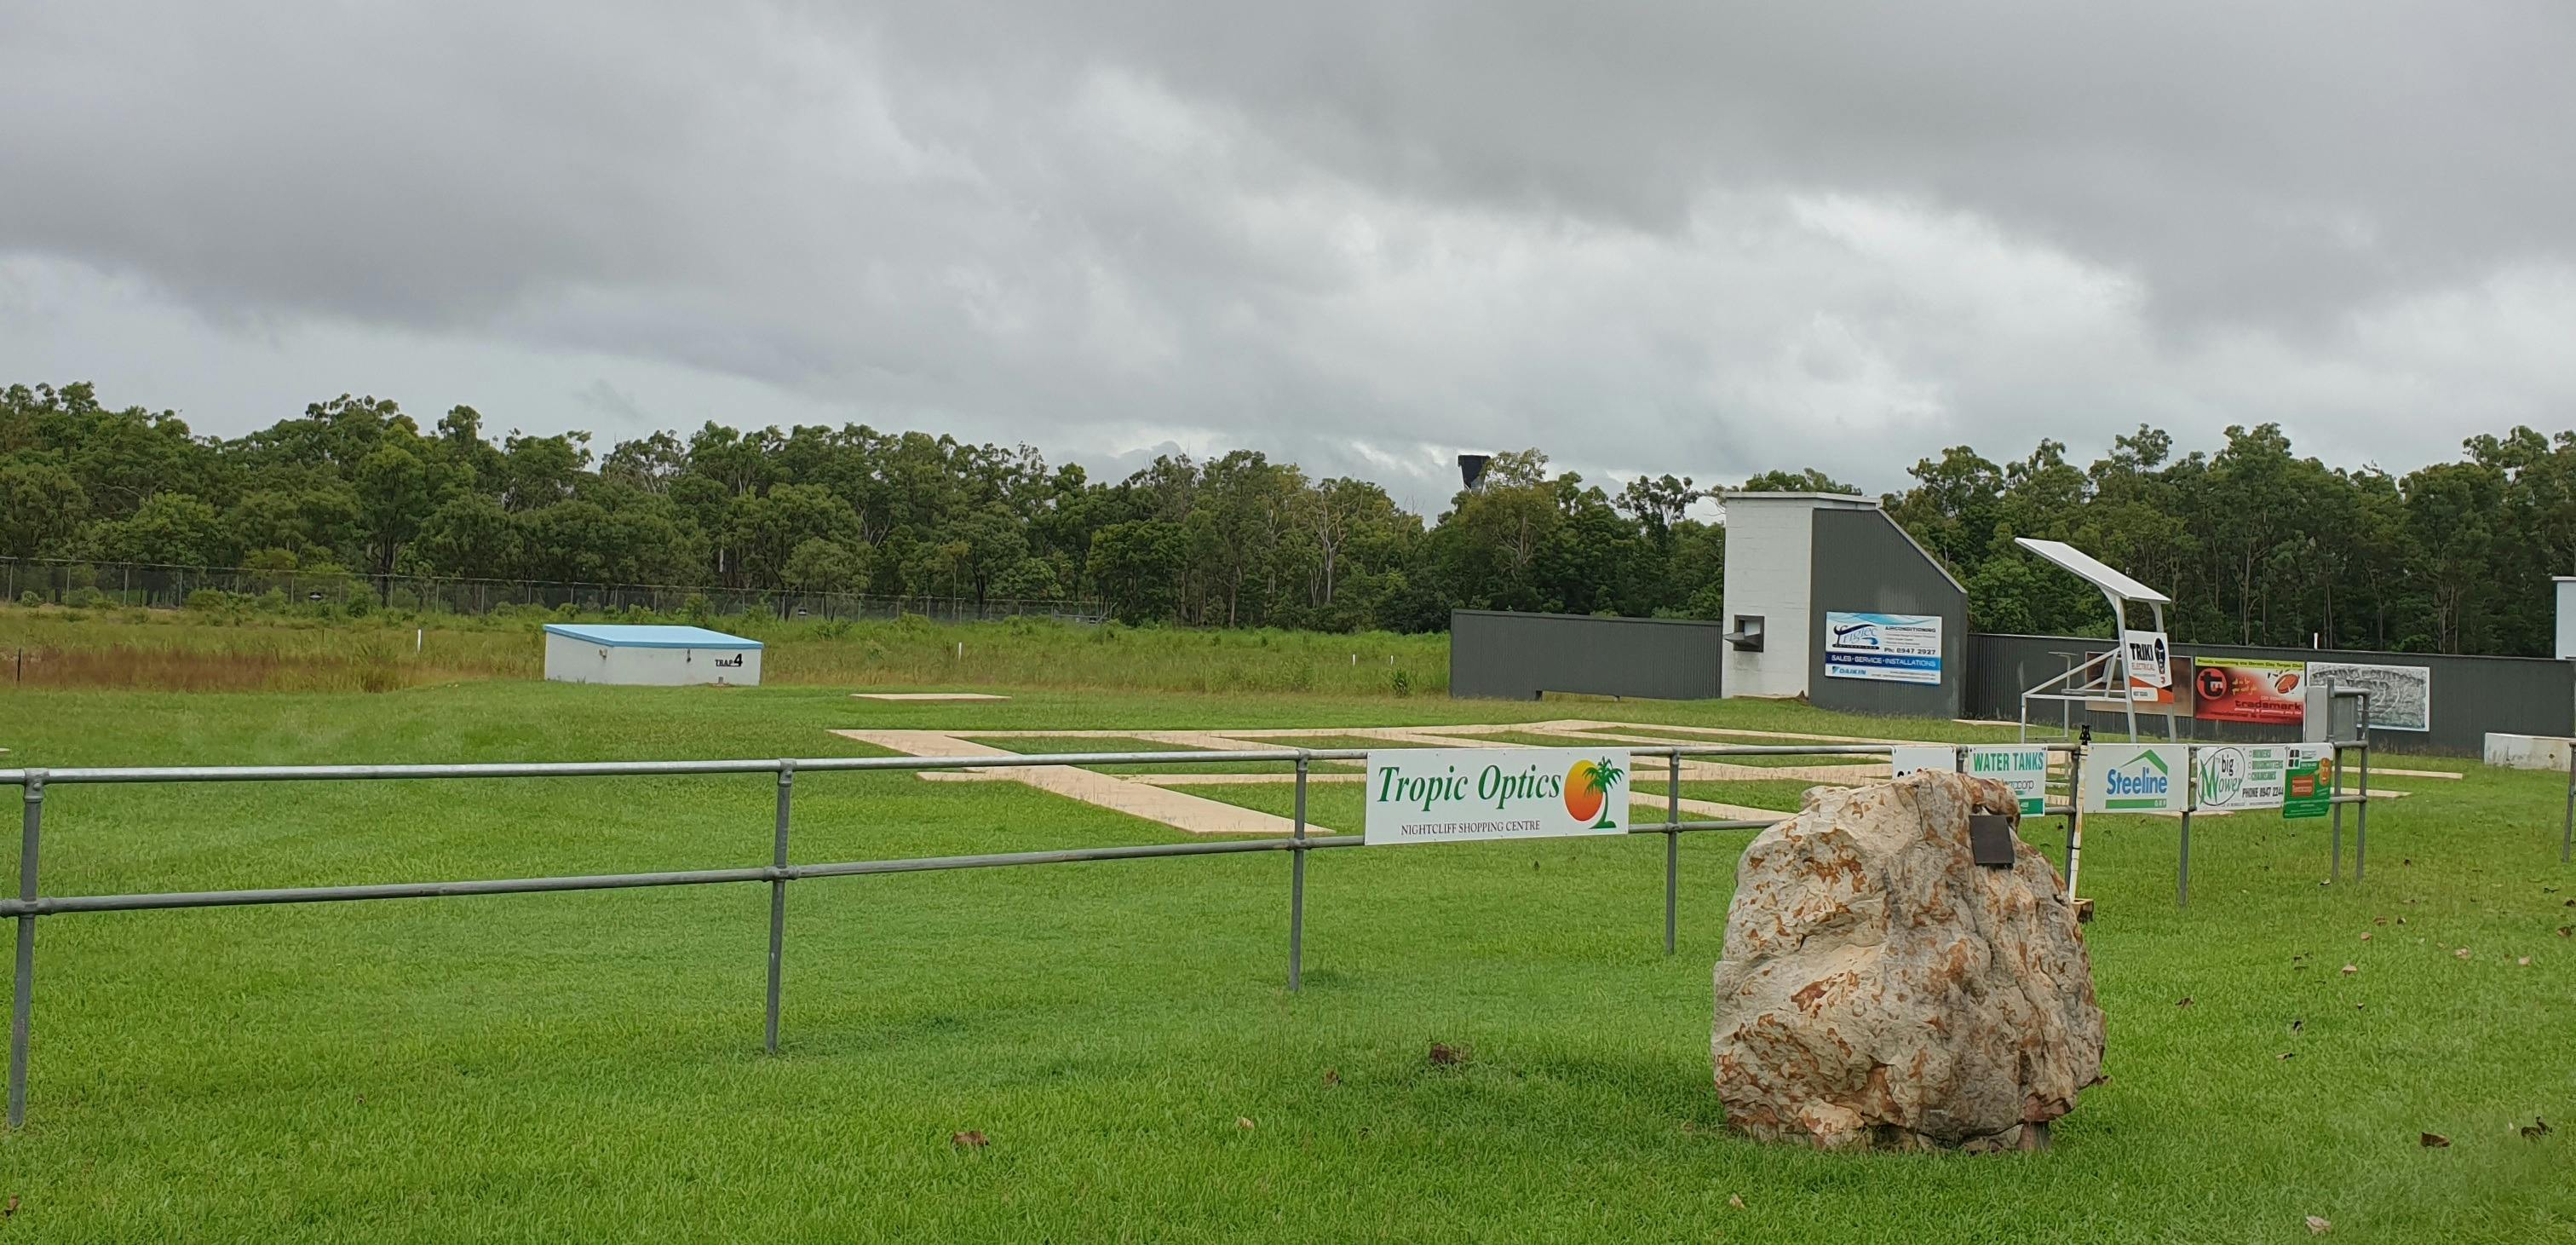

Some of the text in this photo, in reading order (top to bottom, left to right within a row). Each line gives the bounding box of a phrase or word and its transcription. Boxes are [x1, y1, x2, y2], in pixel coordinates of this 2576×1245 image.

[733, 653, 743, 666] 4
[2130, 643, 2154, 661] TRIKI
[1884, 658, 1936, 667] INSTALLATIONS
[2234, 700, 2302, 710] trademark
[1973, 752, 2044, 771] WATER TANKS
[2222, 754, 2234, 776] big
[1377, 764, 1561, 812] Tropic Optics
[2107, 767, 2168, 795] Steeline
[2242, 787, 2258, 798] PHONE
[2259, 786, 2271, 798] 8947
[1401, 820, 1541, 836] NIGHTCLIFF SHOPPING CENTRE
